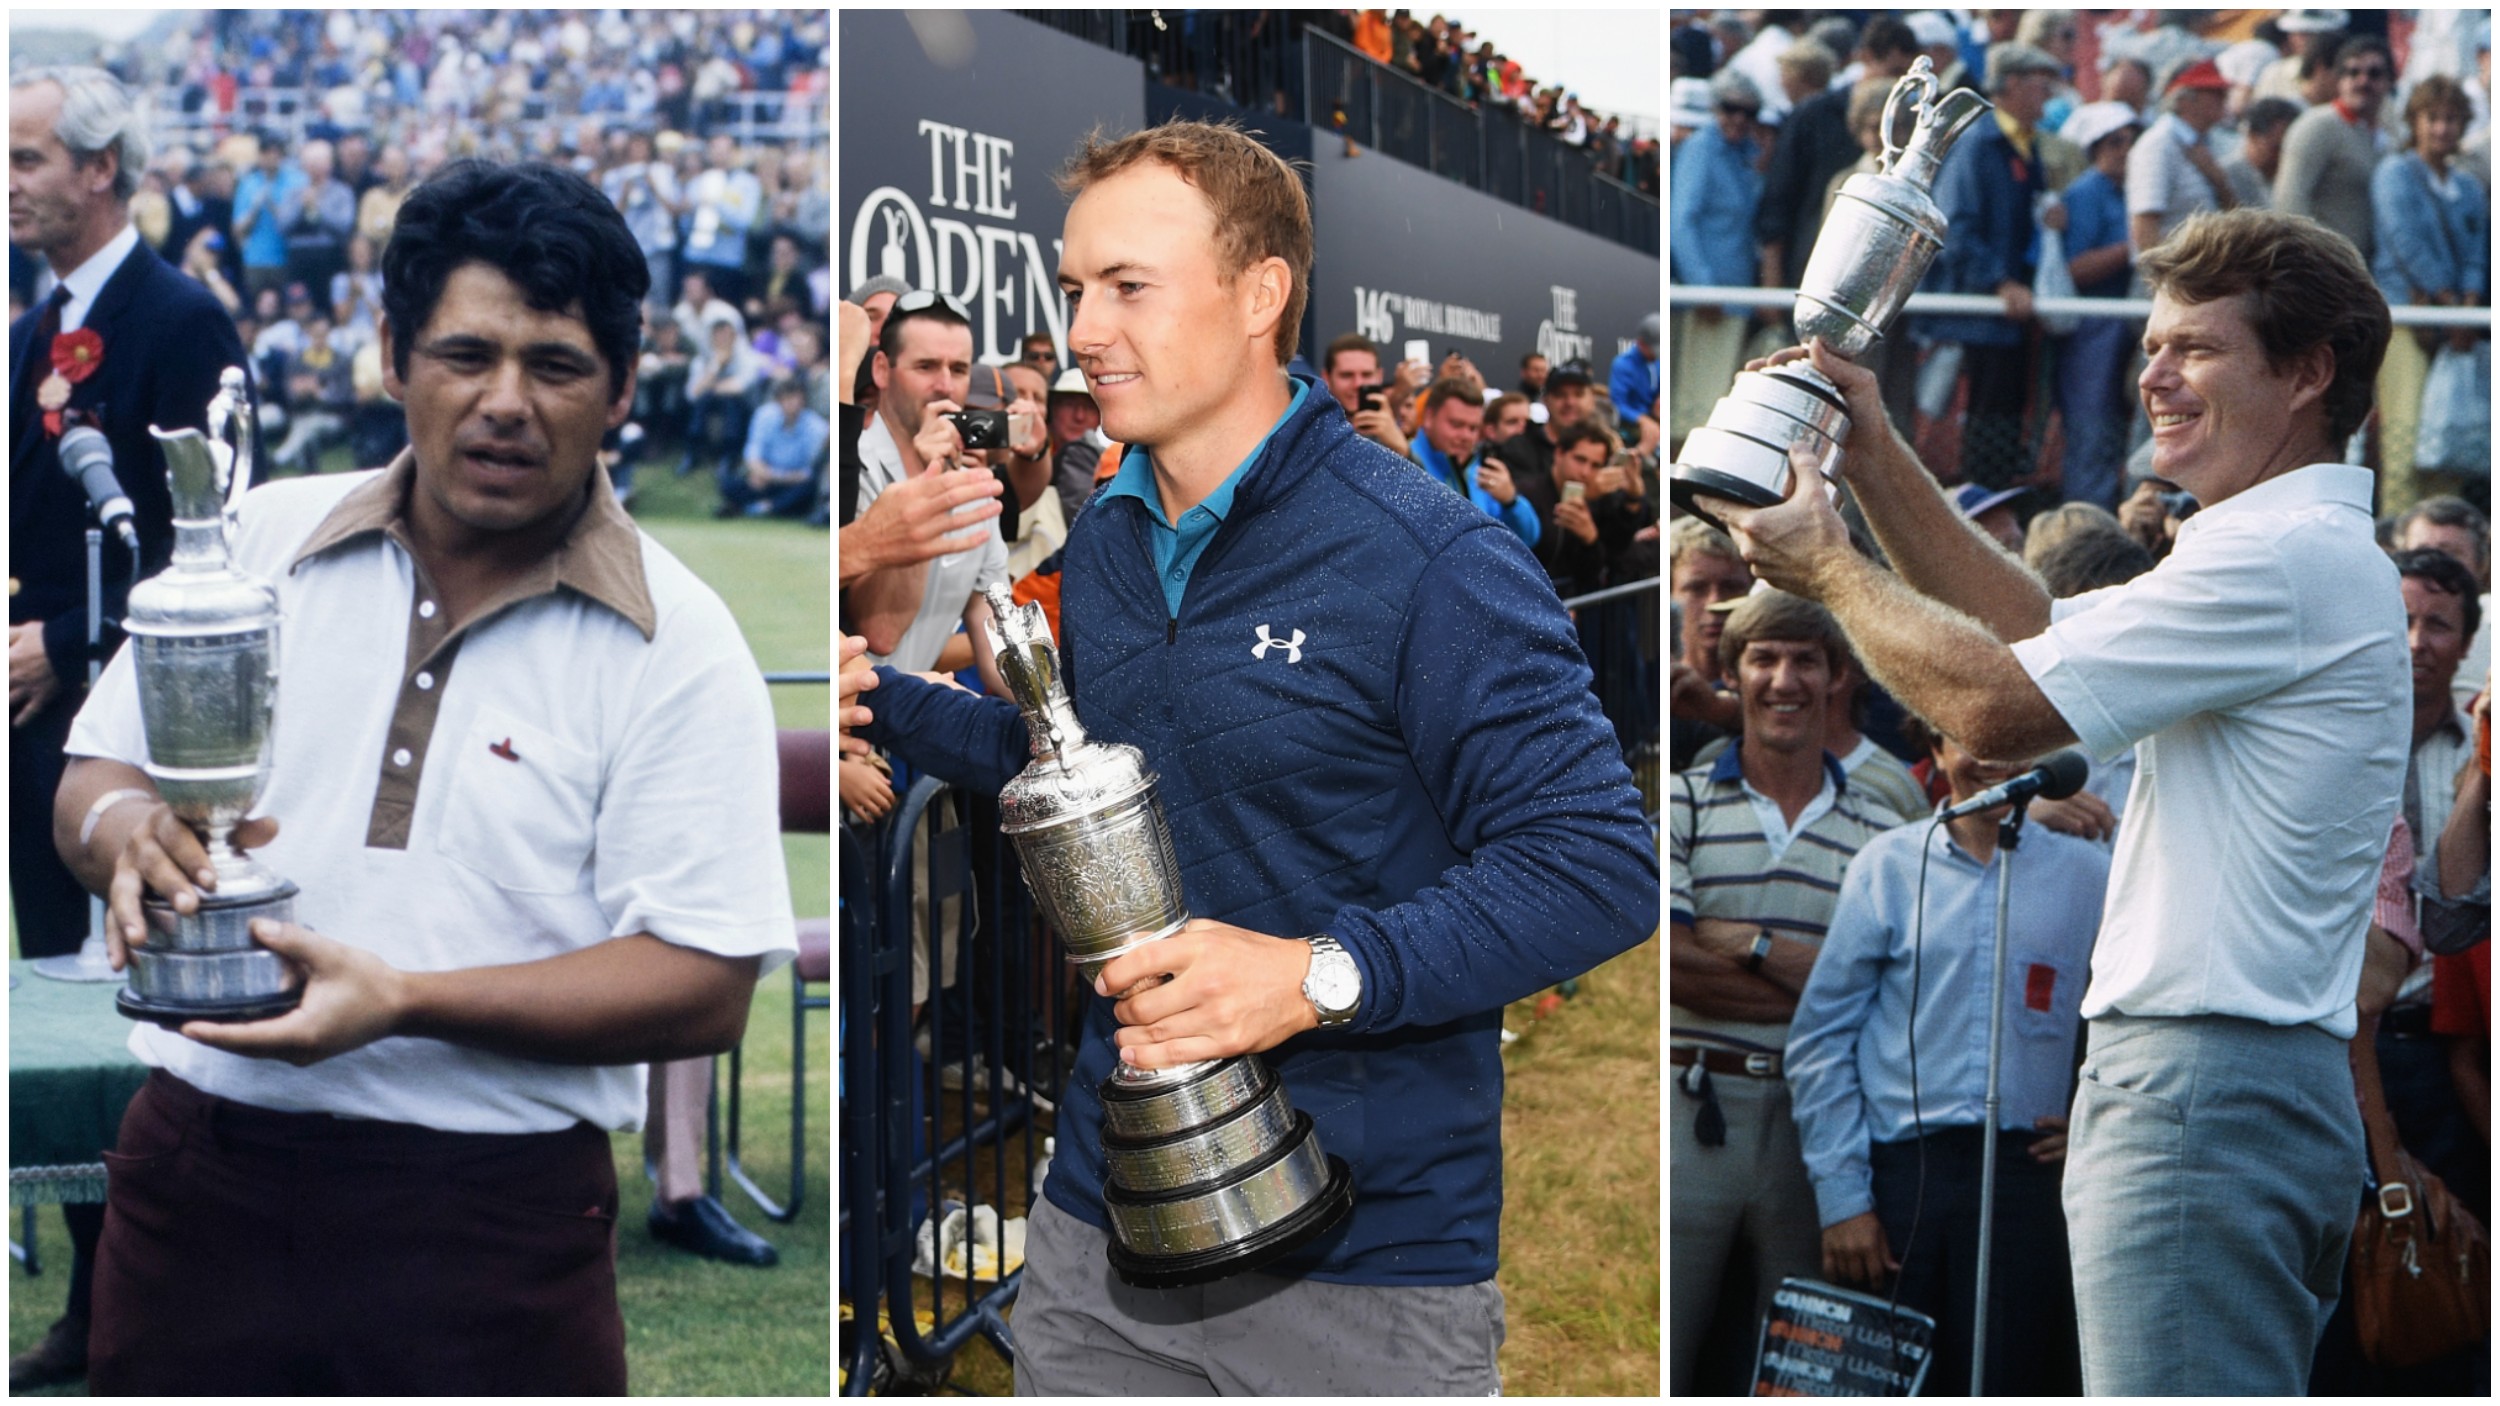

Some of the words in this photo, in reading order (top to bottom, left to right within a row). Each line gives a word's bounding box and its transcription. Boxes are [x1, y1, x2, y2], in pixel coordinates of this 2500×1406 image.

[918, 118, 1017, 220] THE
[849, 186, 1069, 370] OPEN
[1550, 285, 1578, 332] THE
[1404, 296, 1445, 334] ROYAL
[1445, 304, 1502, 343] BIRKDALE
